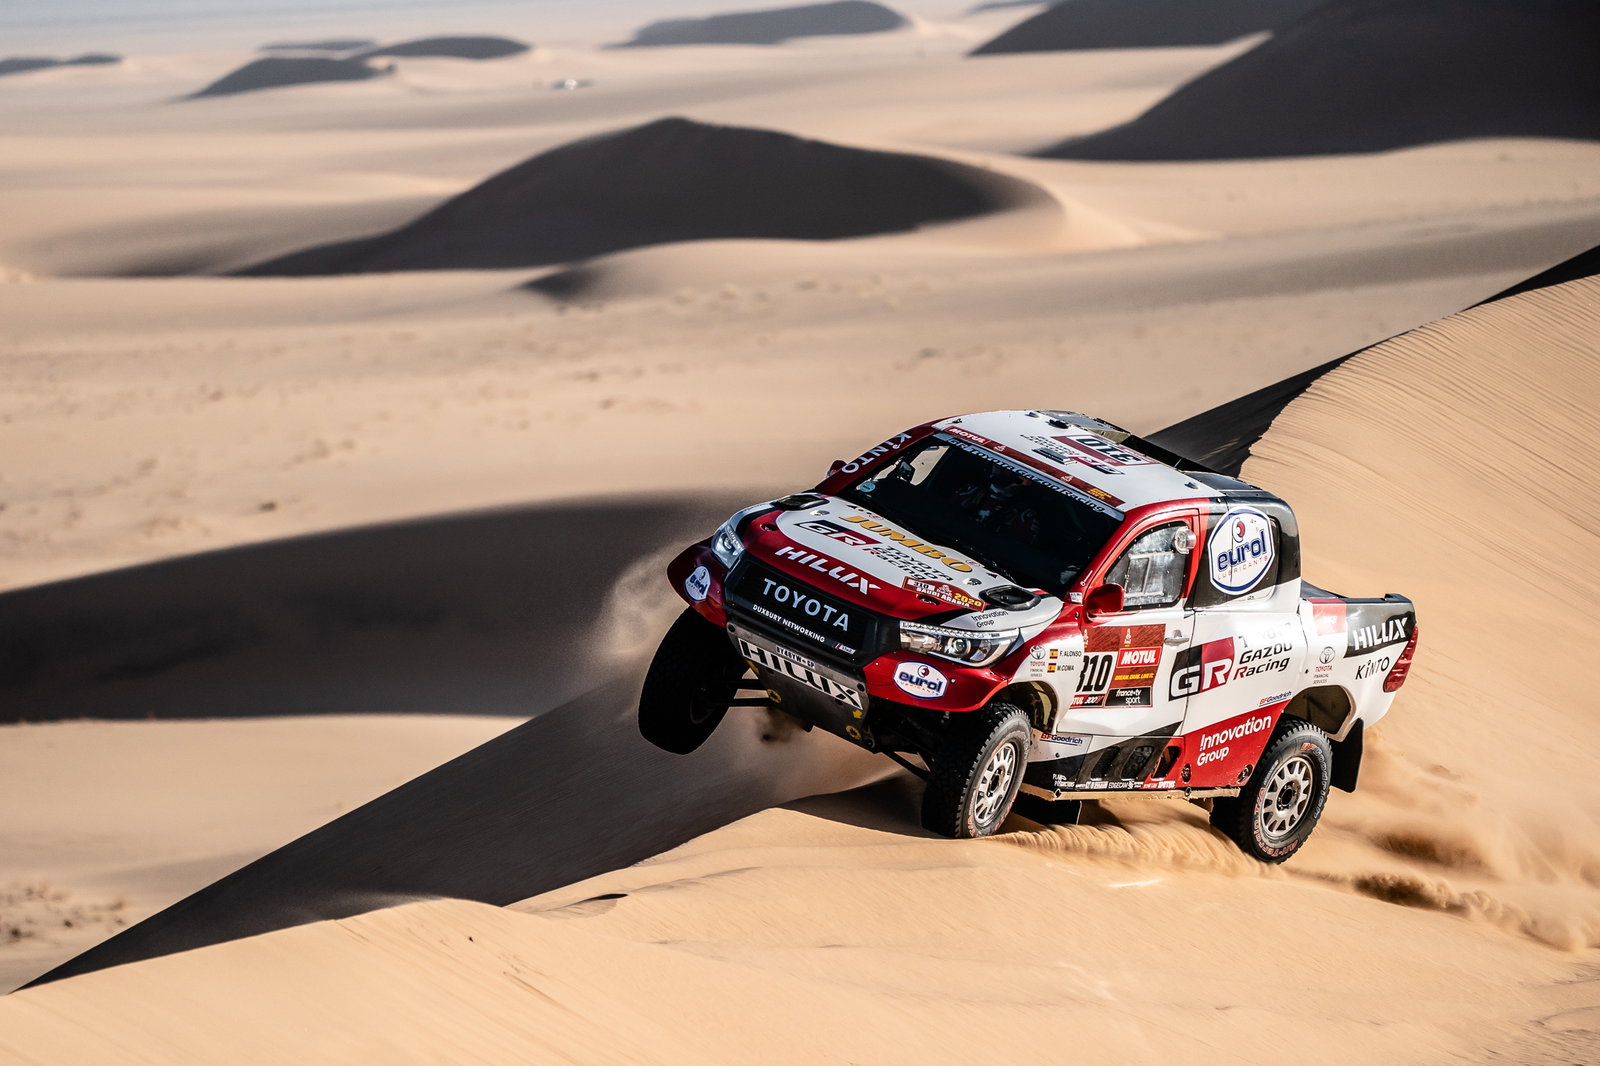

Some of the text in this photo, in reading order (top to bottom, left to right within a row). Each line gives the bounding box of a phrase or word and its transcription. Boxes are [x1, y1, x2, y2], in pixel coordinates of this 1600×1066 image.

[948, 428, 986, 443] MOTUL
[1061, 489, 1105, 513] Racing
[799, 522, 867, 546] GR
[838, 515, 973, 573] JUMBO
[872, 547, 938, 579] GAZOO
[887, 546, 954, 581] TOYOTA
[1217, 530, 1267, 573] eurol
[775, 546, 881, 595] HILUX
[862, 548, 927, 580] Racing
[763, 578, 849, 631] TOYOTA
[916, 587, 940, 597] SAUDI
[941, 594, 971, 607] ARABIA
[954, 592, 982, 607] 2020
[752, 604, 825, 643] DUXBURY NETWORKING
[976, 619, 995, 628] Group
[1353, 617, 1408, 651] HILUX
[1121, 649, 1157, 665] MOTUL
[1239, 643, 1293, 665] GAZOO
[740, 641, 862, 709] HILUX
[1170, 658, 1233, 698] GR
[1233, 657, 1290, 680] Racing
[899, 672, 943, 692] eurol
[1125, 696, 1141, 705] sport
[1040, 733, 1083, 745] BFGoodrich
[1200, 715, 1272, 751] Innovation
[1197, 746, 1230, 766] Group
